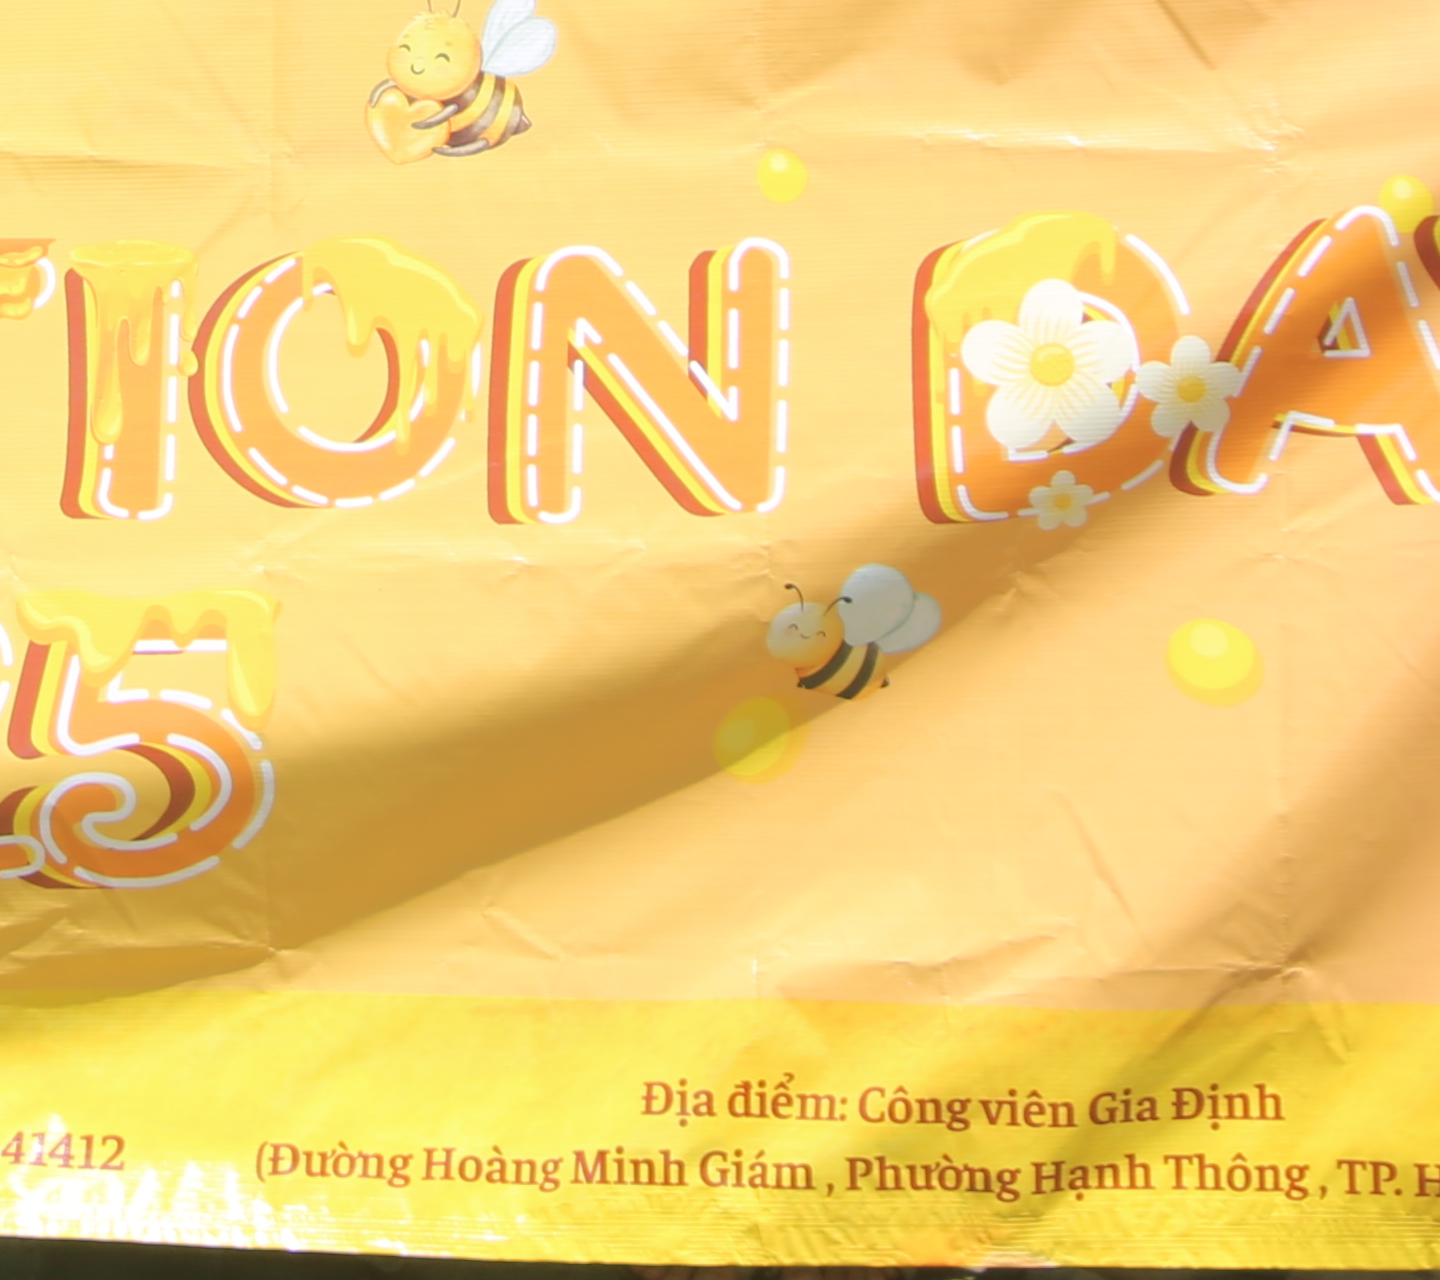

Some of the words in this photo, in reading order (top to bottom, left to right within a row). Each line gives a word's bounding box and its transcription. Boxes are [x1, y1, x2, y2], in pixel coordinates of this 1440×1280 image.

[641, 1078, 717, 1128] Địa
[727, 1072, 848, 1123] điểm:
[858, 1084, 971, 1132] Công
[980, 1089, 1076, 1129] viên
[1088, 1089, 1160, 1127] Gia
[1172, 1084, 1285, 1131] Định
[255, 1139, 413, 1188] (Đường
[422, 1146, 563, 1193] Hoàng
[571, 1144, 689, 1189] Minh
[699, 1150, 815, 1190] Giám
[845, 1155, 1021, 1202] Phường
[1030, 1156, 1153, 1202] Hạnh
[1164, 1153, 1310, 1200] Thông
[1337, 1158, 1404, 1197] TP.
